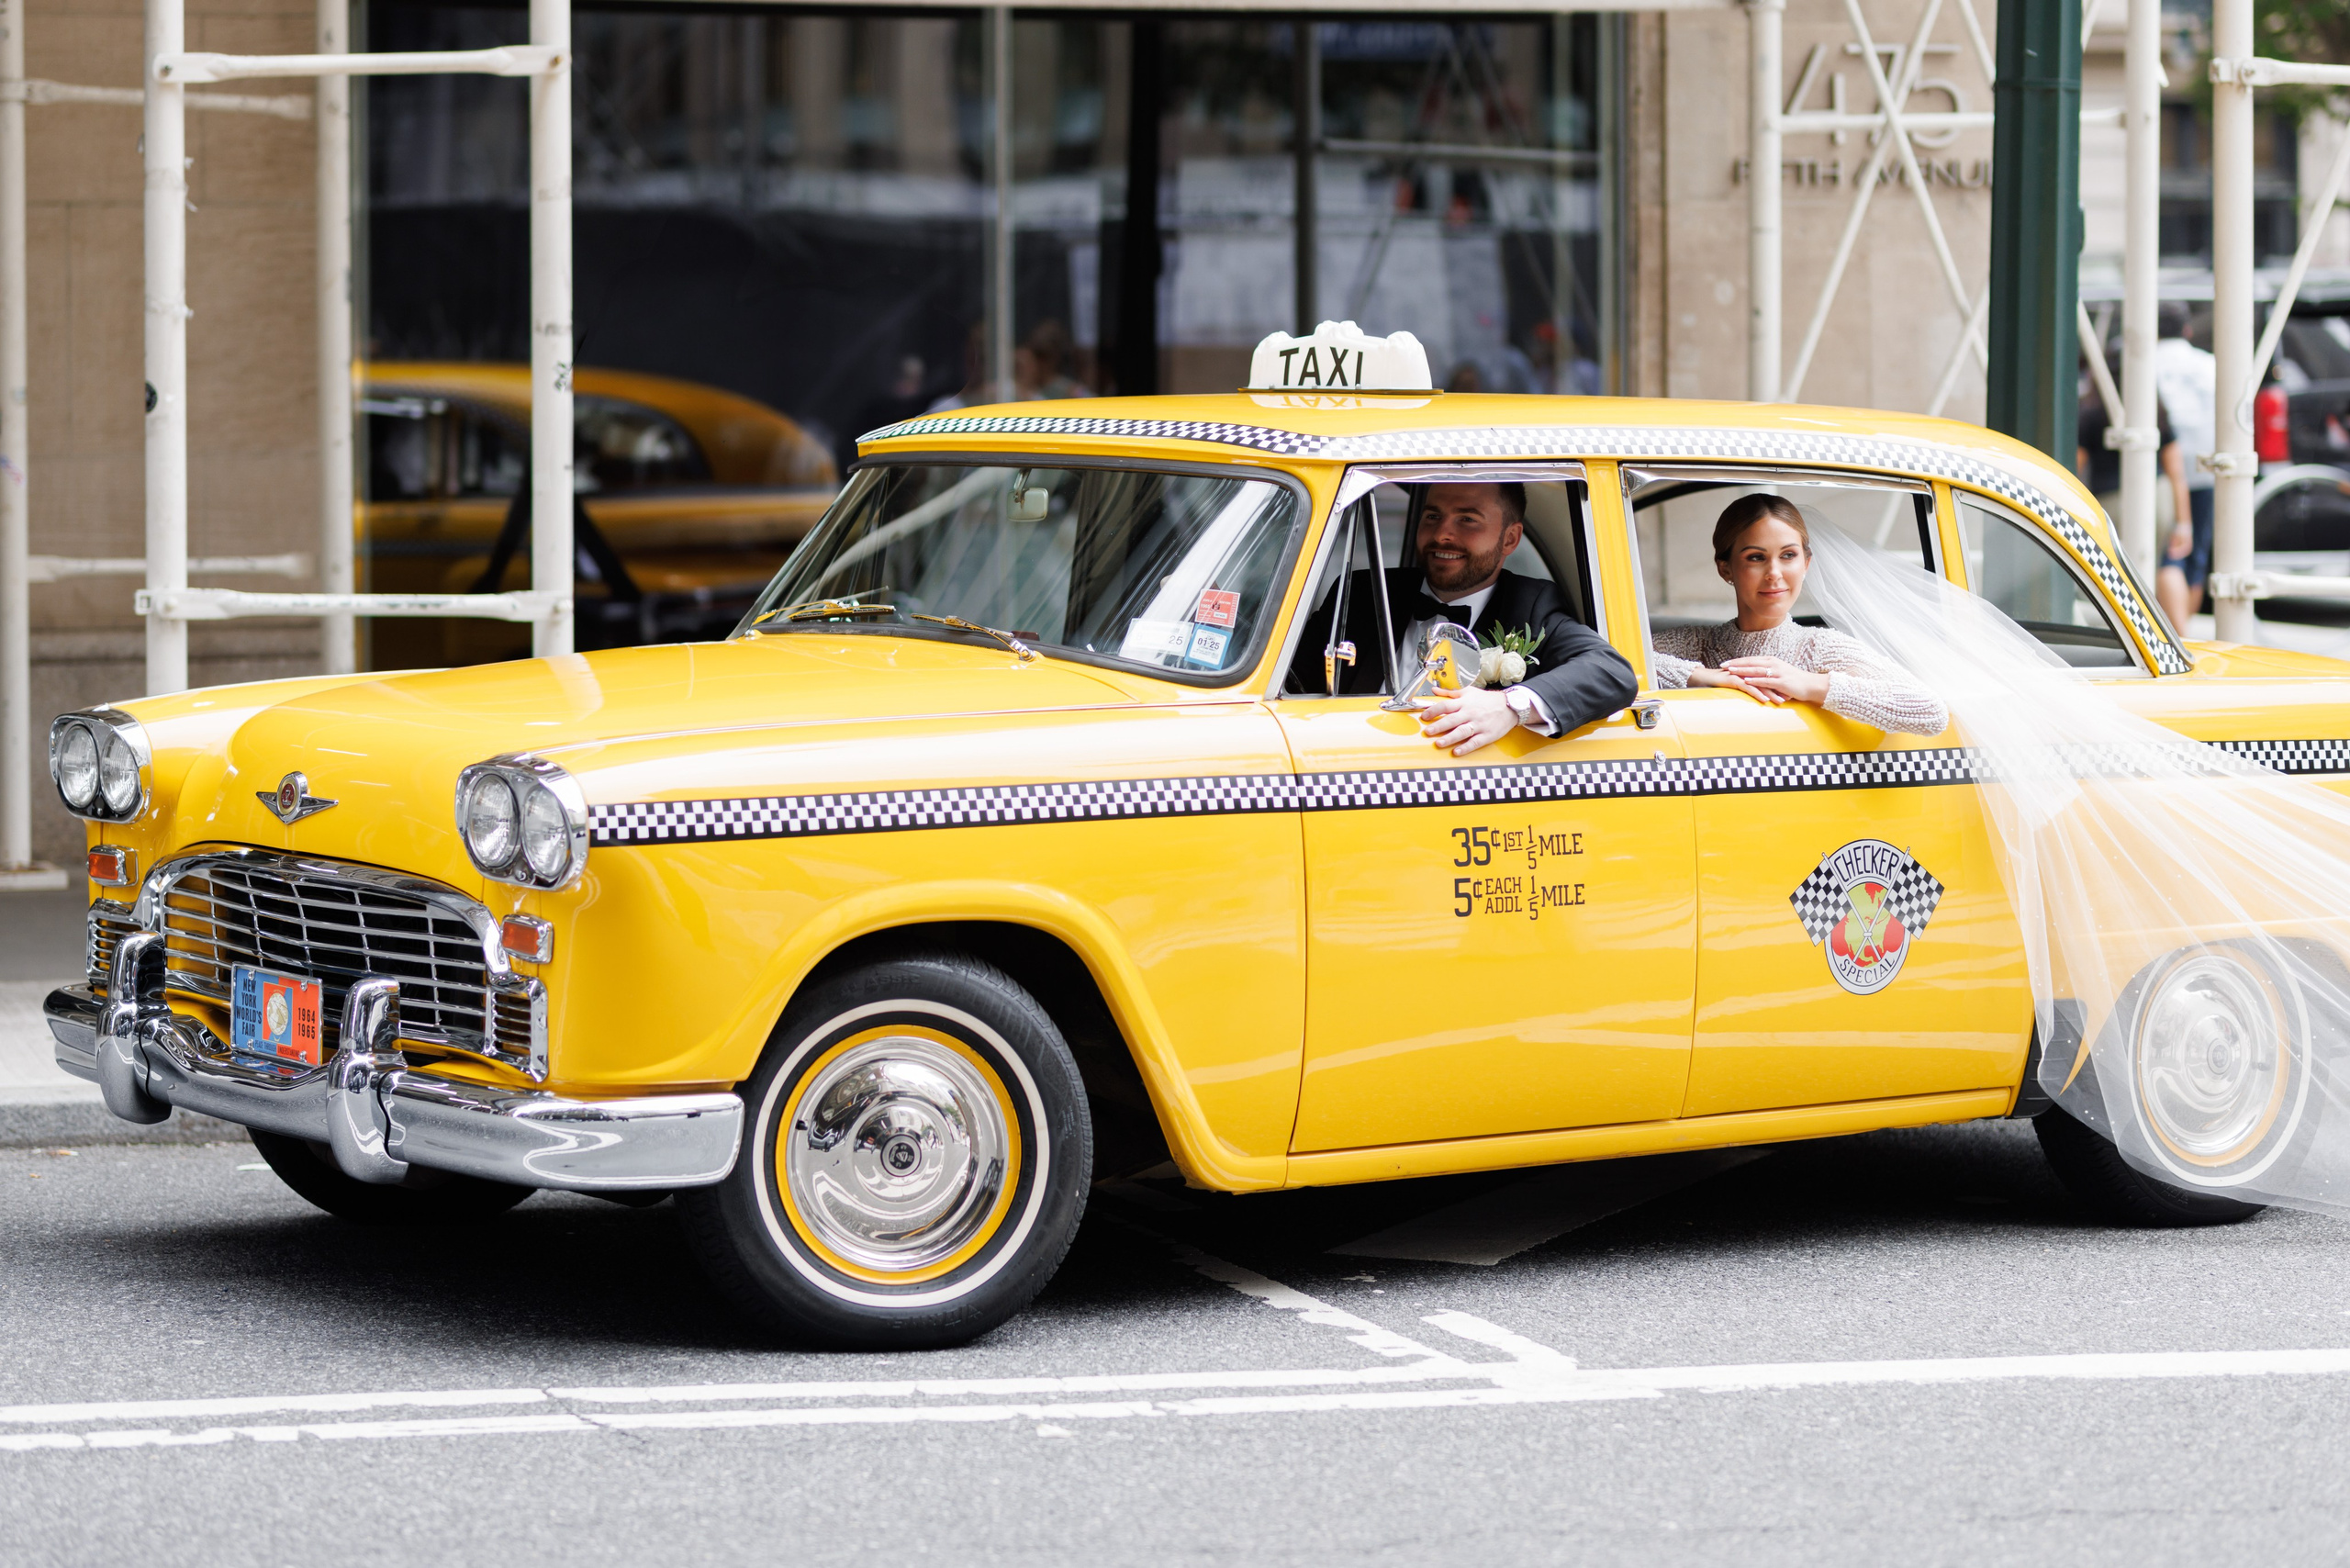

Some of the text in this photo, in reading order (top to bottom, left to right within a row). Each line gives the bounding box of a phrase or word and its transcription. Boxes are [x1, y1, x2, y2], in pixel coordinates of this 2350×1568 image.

[1785, 42, 1972, 149] 475
[1279, 346, 1363, 386] TAXI
[1504, 831, 1524, 852] 1ST
[1539, 833, 1583, 857] MILE
[1833, 845, 1900, 882] CHECKER
[1485, 877, 1522, 895] EACH
[1541, 883, 1585, 907] MILE
[1484, 895, 1523, 914] ADDL
[1840, 958, 1896, 984] SPECIAL
[243, 979, 257, 993] NEW
[241, 993, 257, 1009] YORK
[236, 1005, 263, 1024] WORLD'S
[297, 1007, 316, 1024] 1964
[241, 1023, 256, 1037] FAIR
[297, 1023, 316, 1039] 1965
